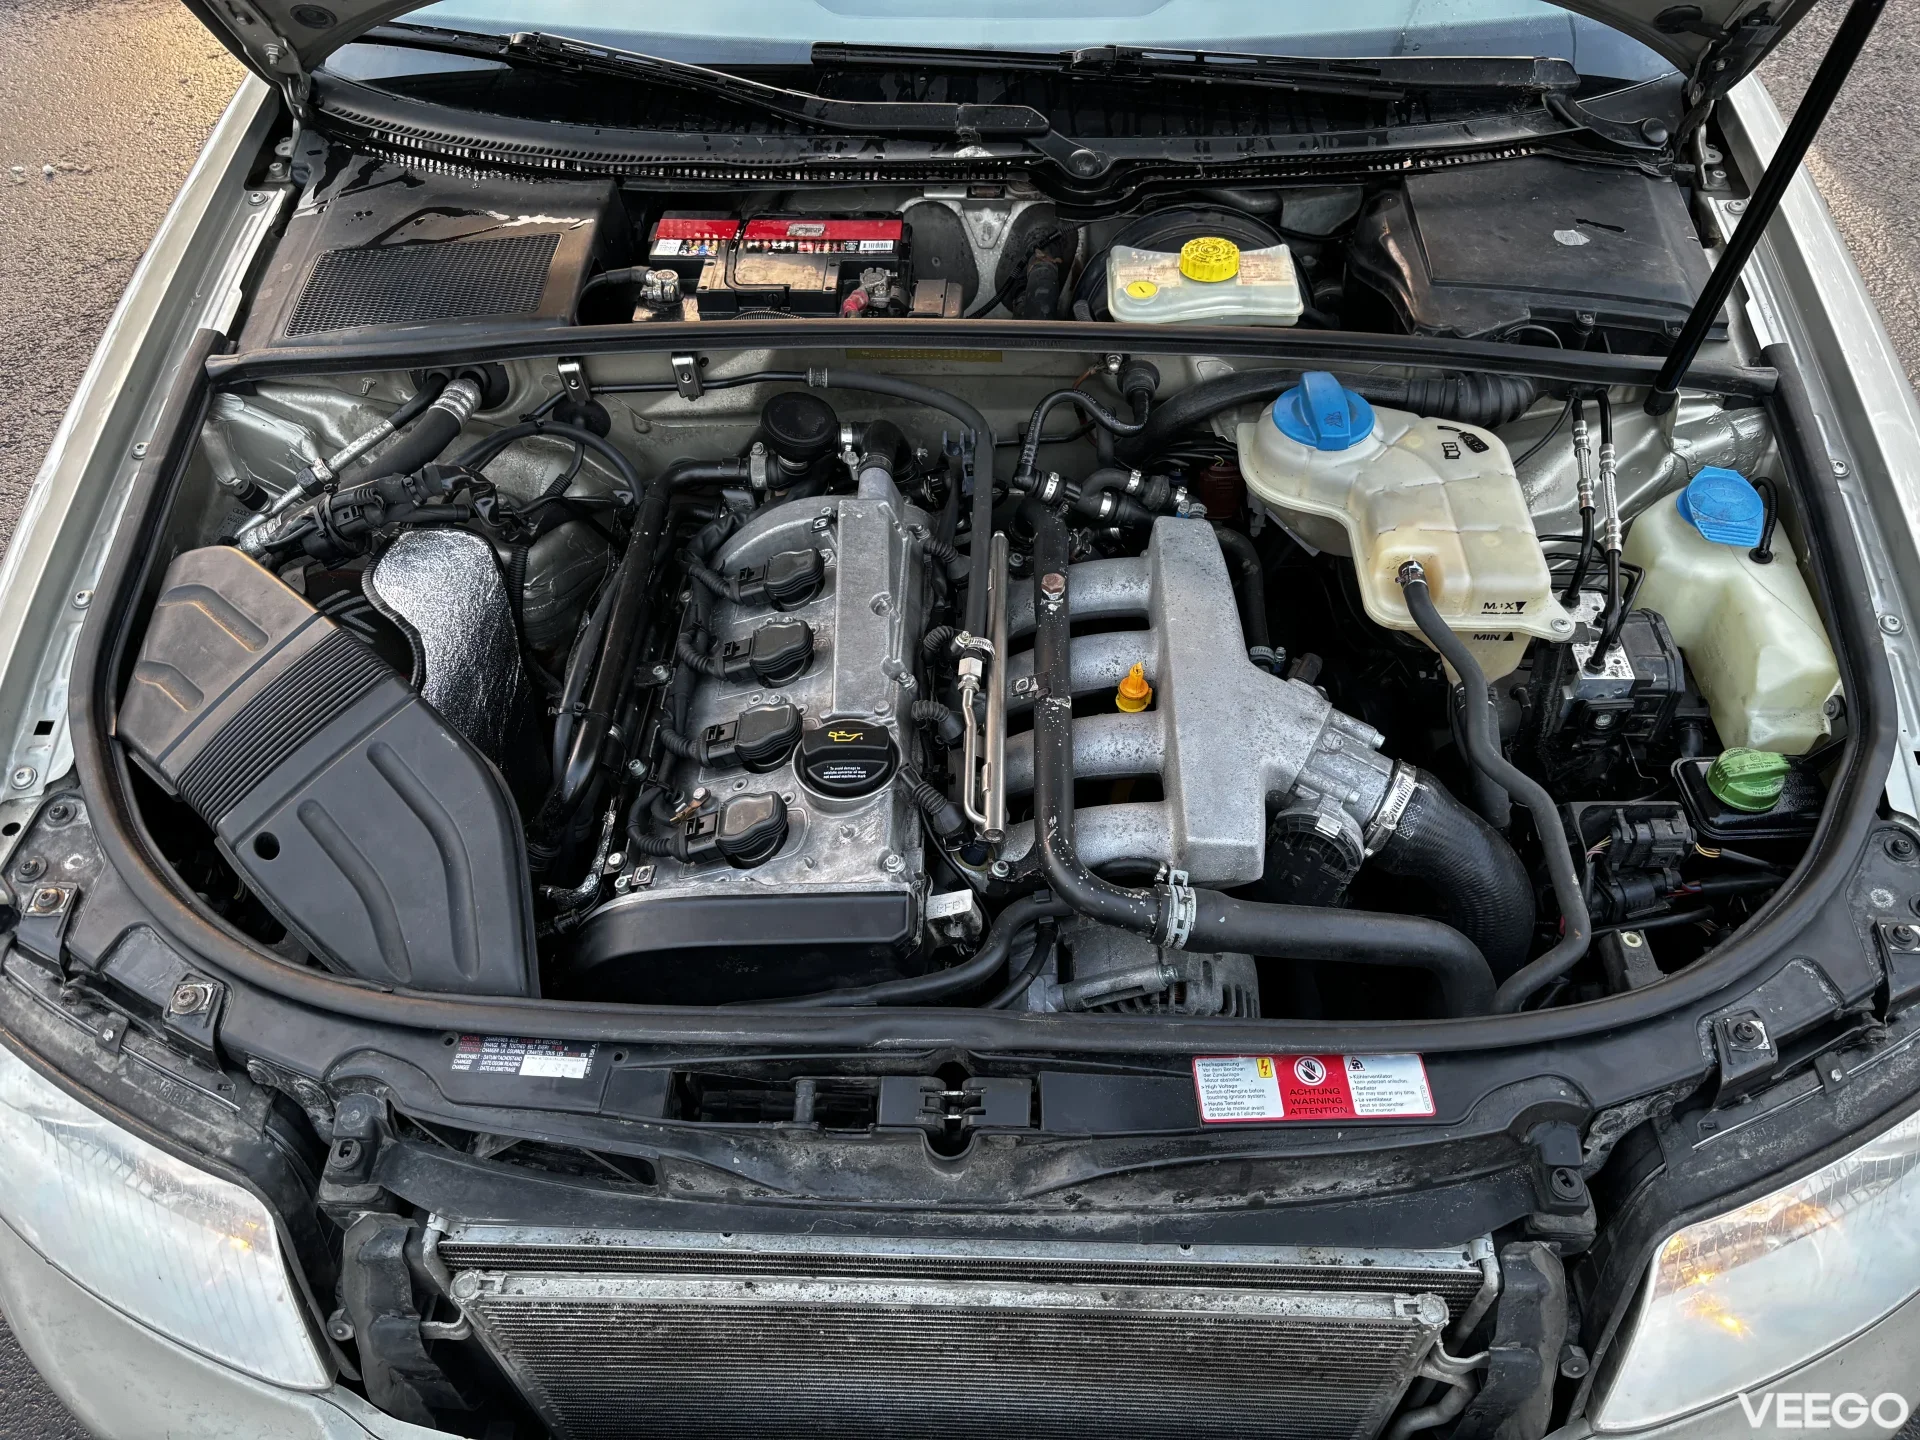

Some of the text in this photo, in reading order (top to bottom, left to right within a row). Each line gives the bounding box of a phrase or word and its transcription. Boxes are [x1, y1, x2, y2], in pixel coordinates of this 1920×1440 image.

[1483, 602, 1514, 610] MX
[1473, 633, 1501, 641] MIN
[1290, 1088, 1340, 1096] ACHTUNG
[1290, 1097, 1343, 1105] WARNING
[1290, 1106, 1348, 1115] ATTENTION
